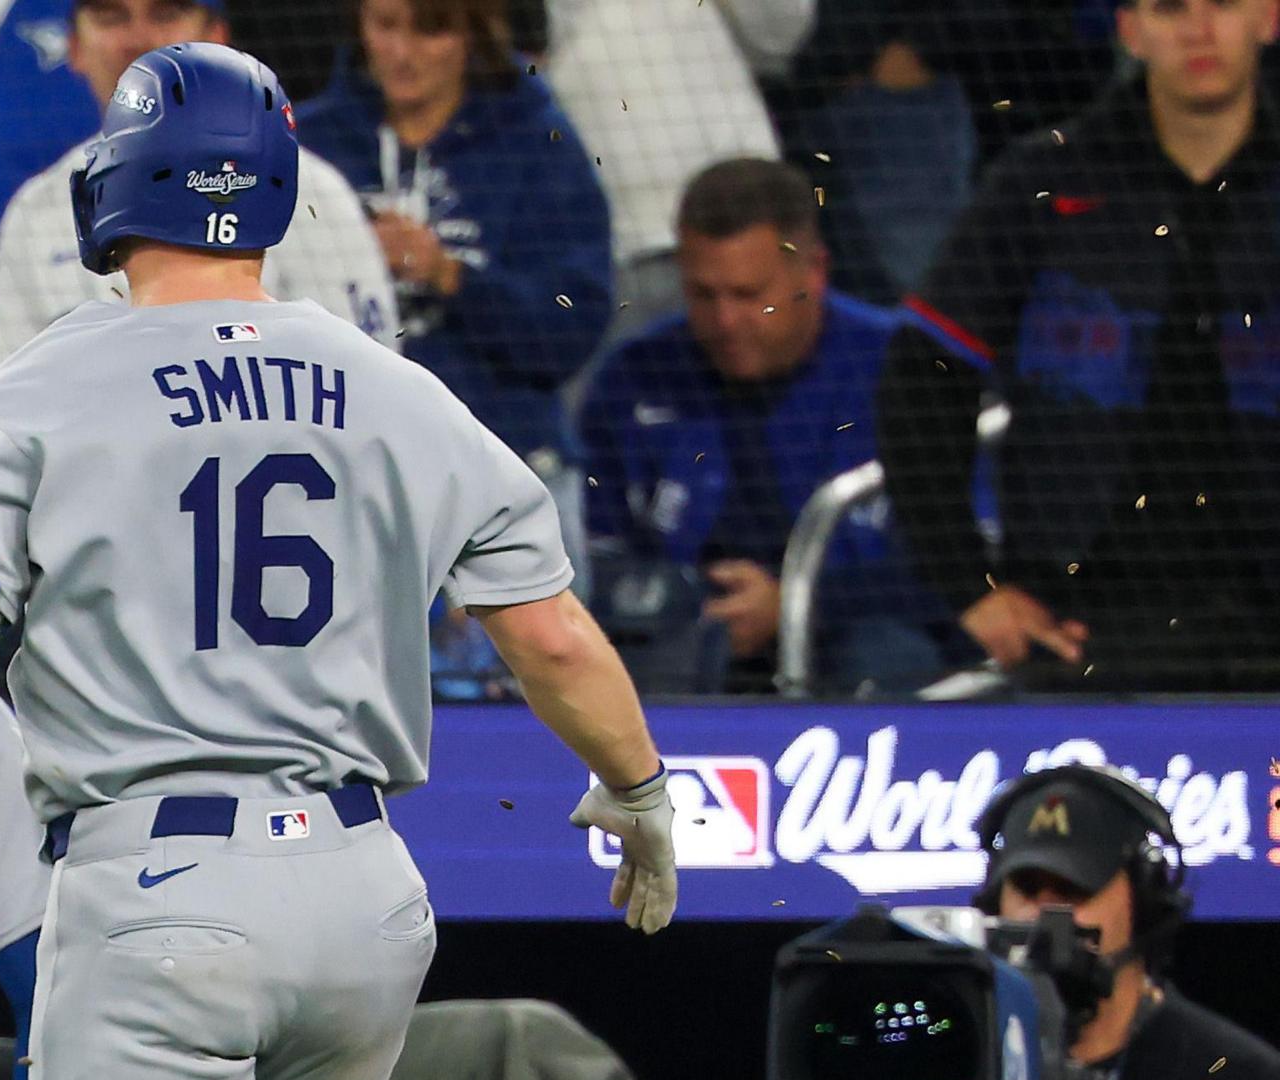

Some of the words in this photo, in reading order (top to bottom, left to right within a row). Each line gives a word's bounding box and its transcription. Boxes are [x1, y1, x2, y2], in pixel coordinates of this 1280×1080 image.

[206, 212, 239, 244] 16
[152, 356, 346, 430] SMITH
[179, 453, 336, 652] 16
[773, 724, 1012, 863] Worl
